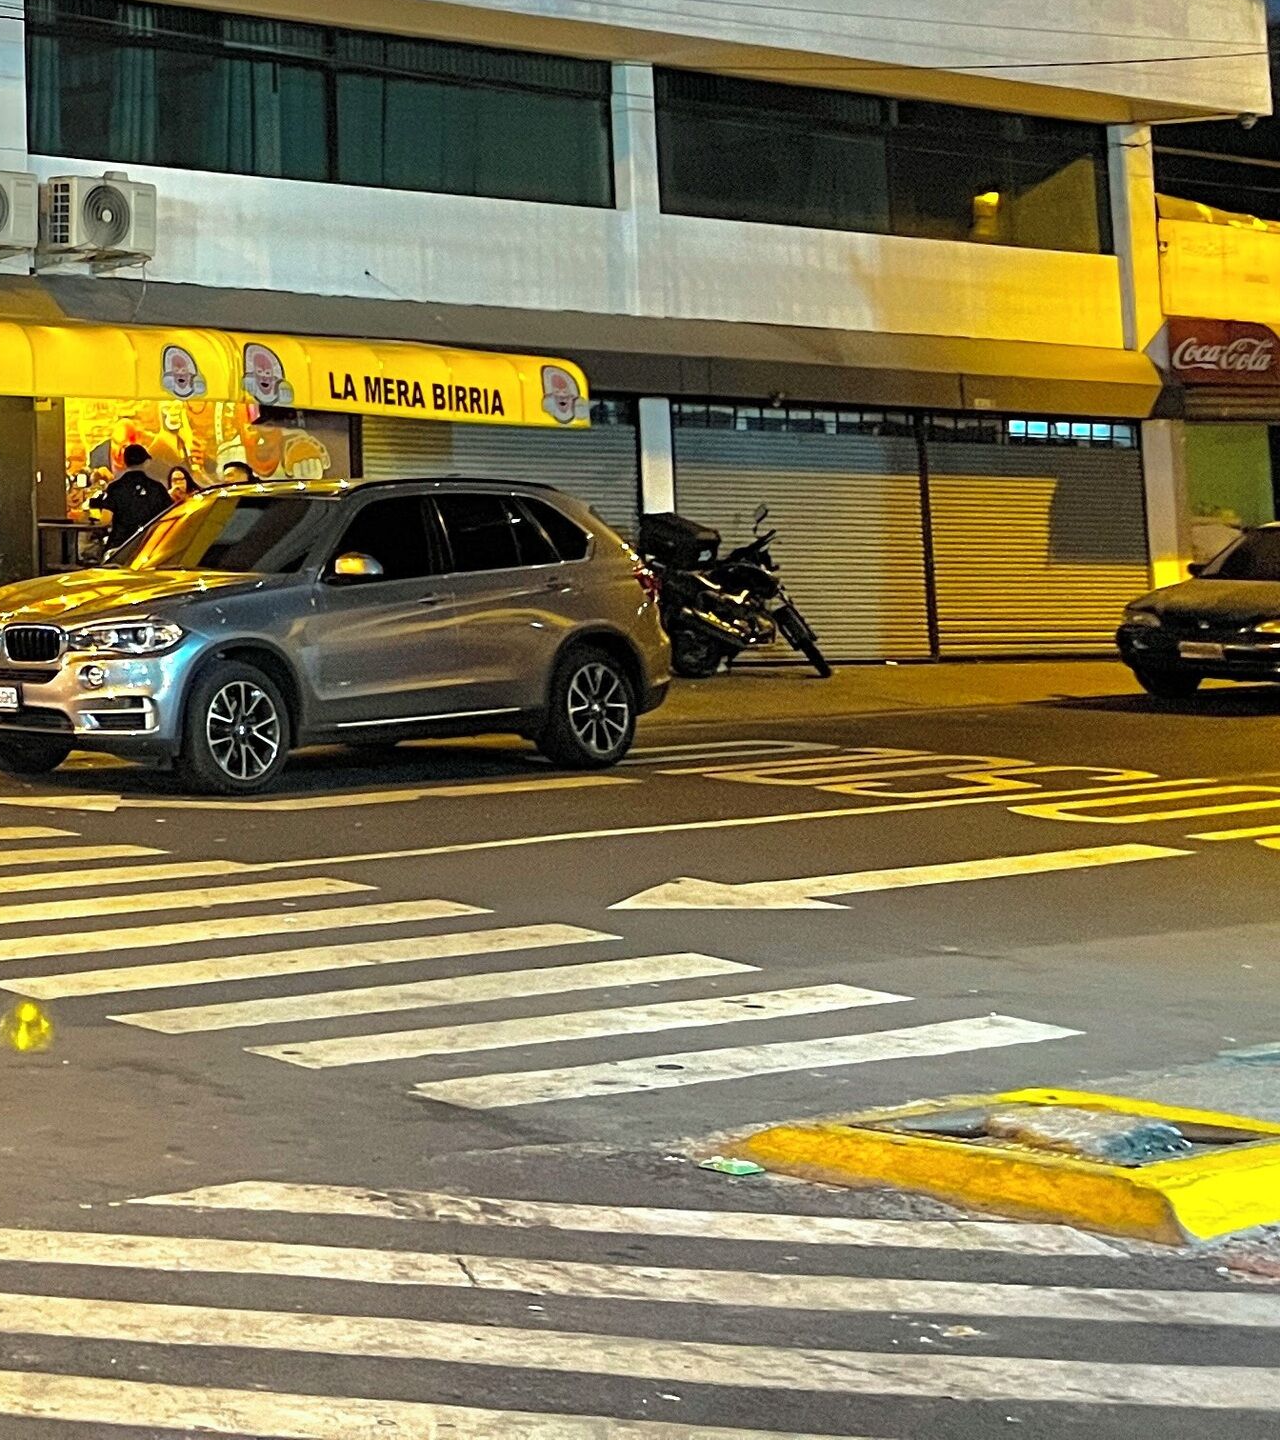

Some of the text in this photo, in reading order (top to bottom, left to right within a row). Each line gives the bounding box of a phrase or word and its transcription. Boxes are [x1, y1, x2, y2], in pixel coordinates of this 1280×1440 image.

[1172, 337, 1274, 371] Coca-Cola
[329, 372, 505, 416] LA MERA BIRRIA
